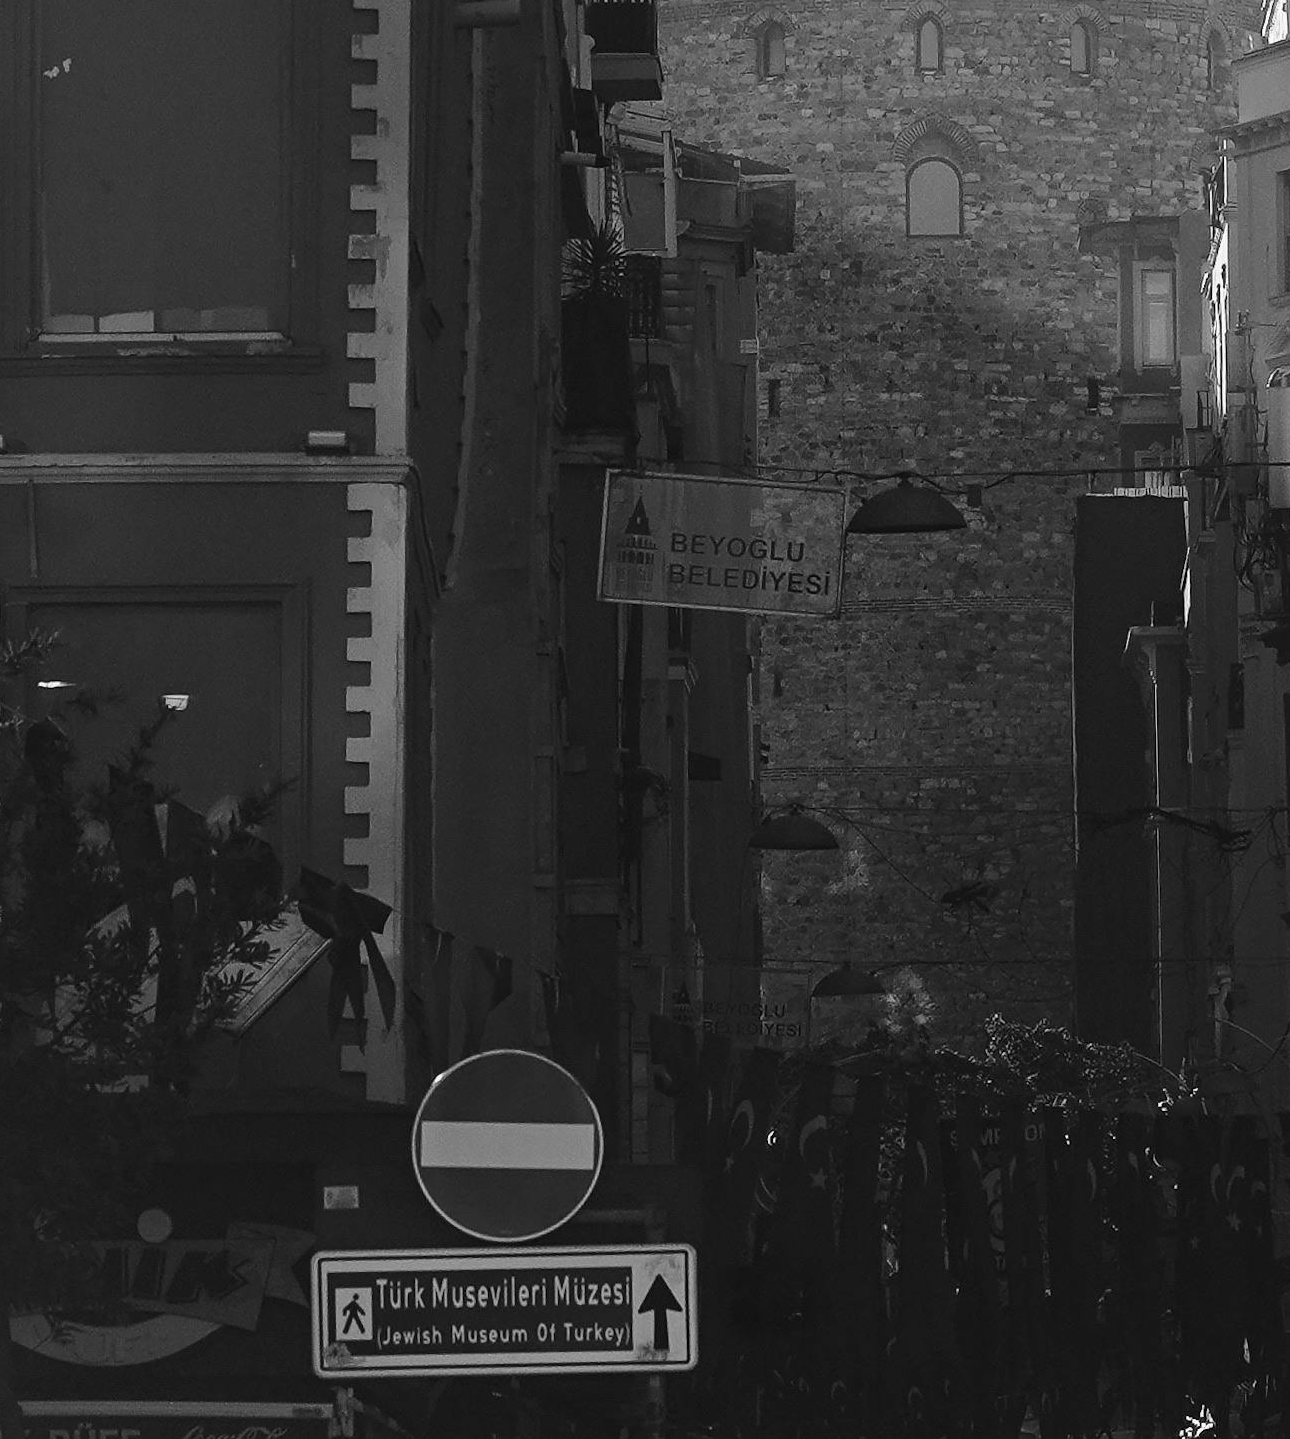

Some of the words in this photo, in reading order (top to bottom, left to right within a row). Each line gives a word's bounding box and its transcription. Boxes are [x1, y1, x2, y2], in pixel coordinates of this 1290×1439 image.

[670, 529, 805, 563] BEYOĞLU
[668, 563, 830, 596] BELEDİYESİ
[375, 1277, 425, 1310] Türk
[432, 1275, 547, 1309] Musevileri
[554, 1274, 630, 1307] Müzesi
[376, 1326, 442, 1350] (Jewish
[451, 1325, 528, 1345] Museum
[537, 1323, 556, 1343] Of
[564, 1321, 631, 1346] Turkey)
